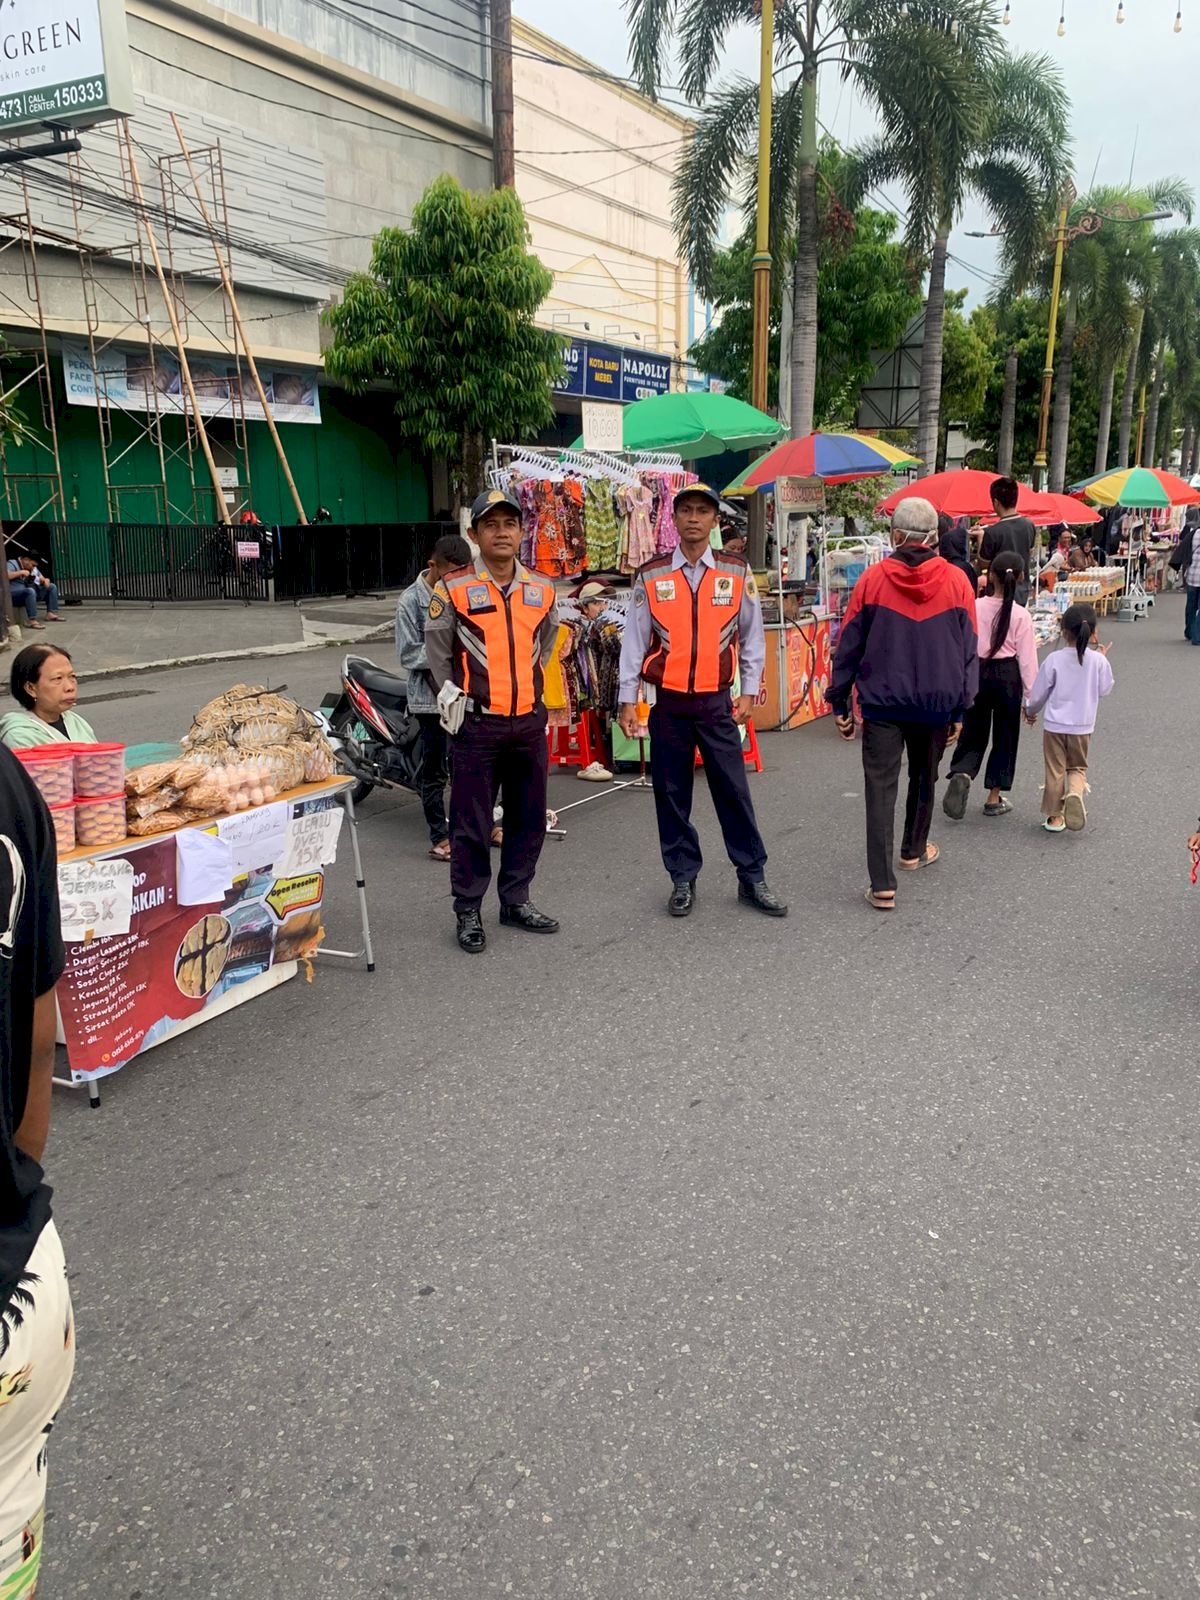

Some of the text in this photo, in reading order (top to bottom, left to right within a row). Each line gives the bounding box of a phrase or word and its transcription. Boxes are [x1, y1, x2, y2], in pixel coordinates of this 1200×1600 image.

[0, 17, 81, 60] GREEN
[0, 65, 46, 82] skin care
[28, 93, 45, 103] CALL
[54, 80, 104, 107] 150333
[29, 100, 56, 113] CENTER
[560, 347, 579, 363] ND
[589, 357, 620, 371] KOTA BARU
[623, 358, 669, 379] NAPOLLY
[70, 372, 92, 382] FACE
[594, 372, 613, 384] MEBEL
[624, 375, 645, 386] FURNITURE
[133, 872, 147, 887] OD
[271, 885, 291, 897] Open
[131, 886, 165, 914] AKAN
[82, 996, 109, 1011] Jagung
